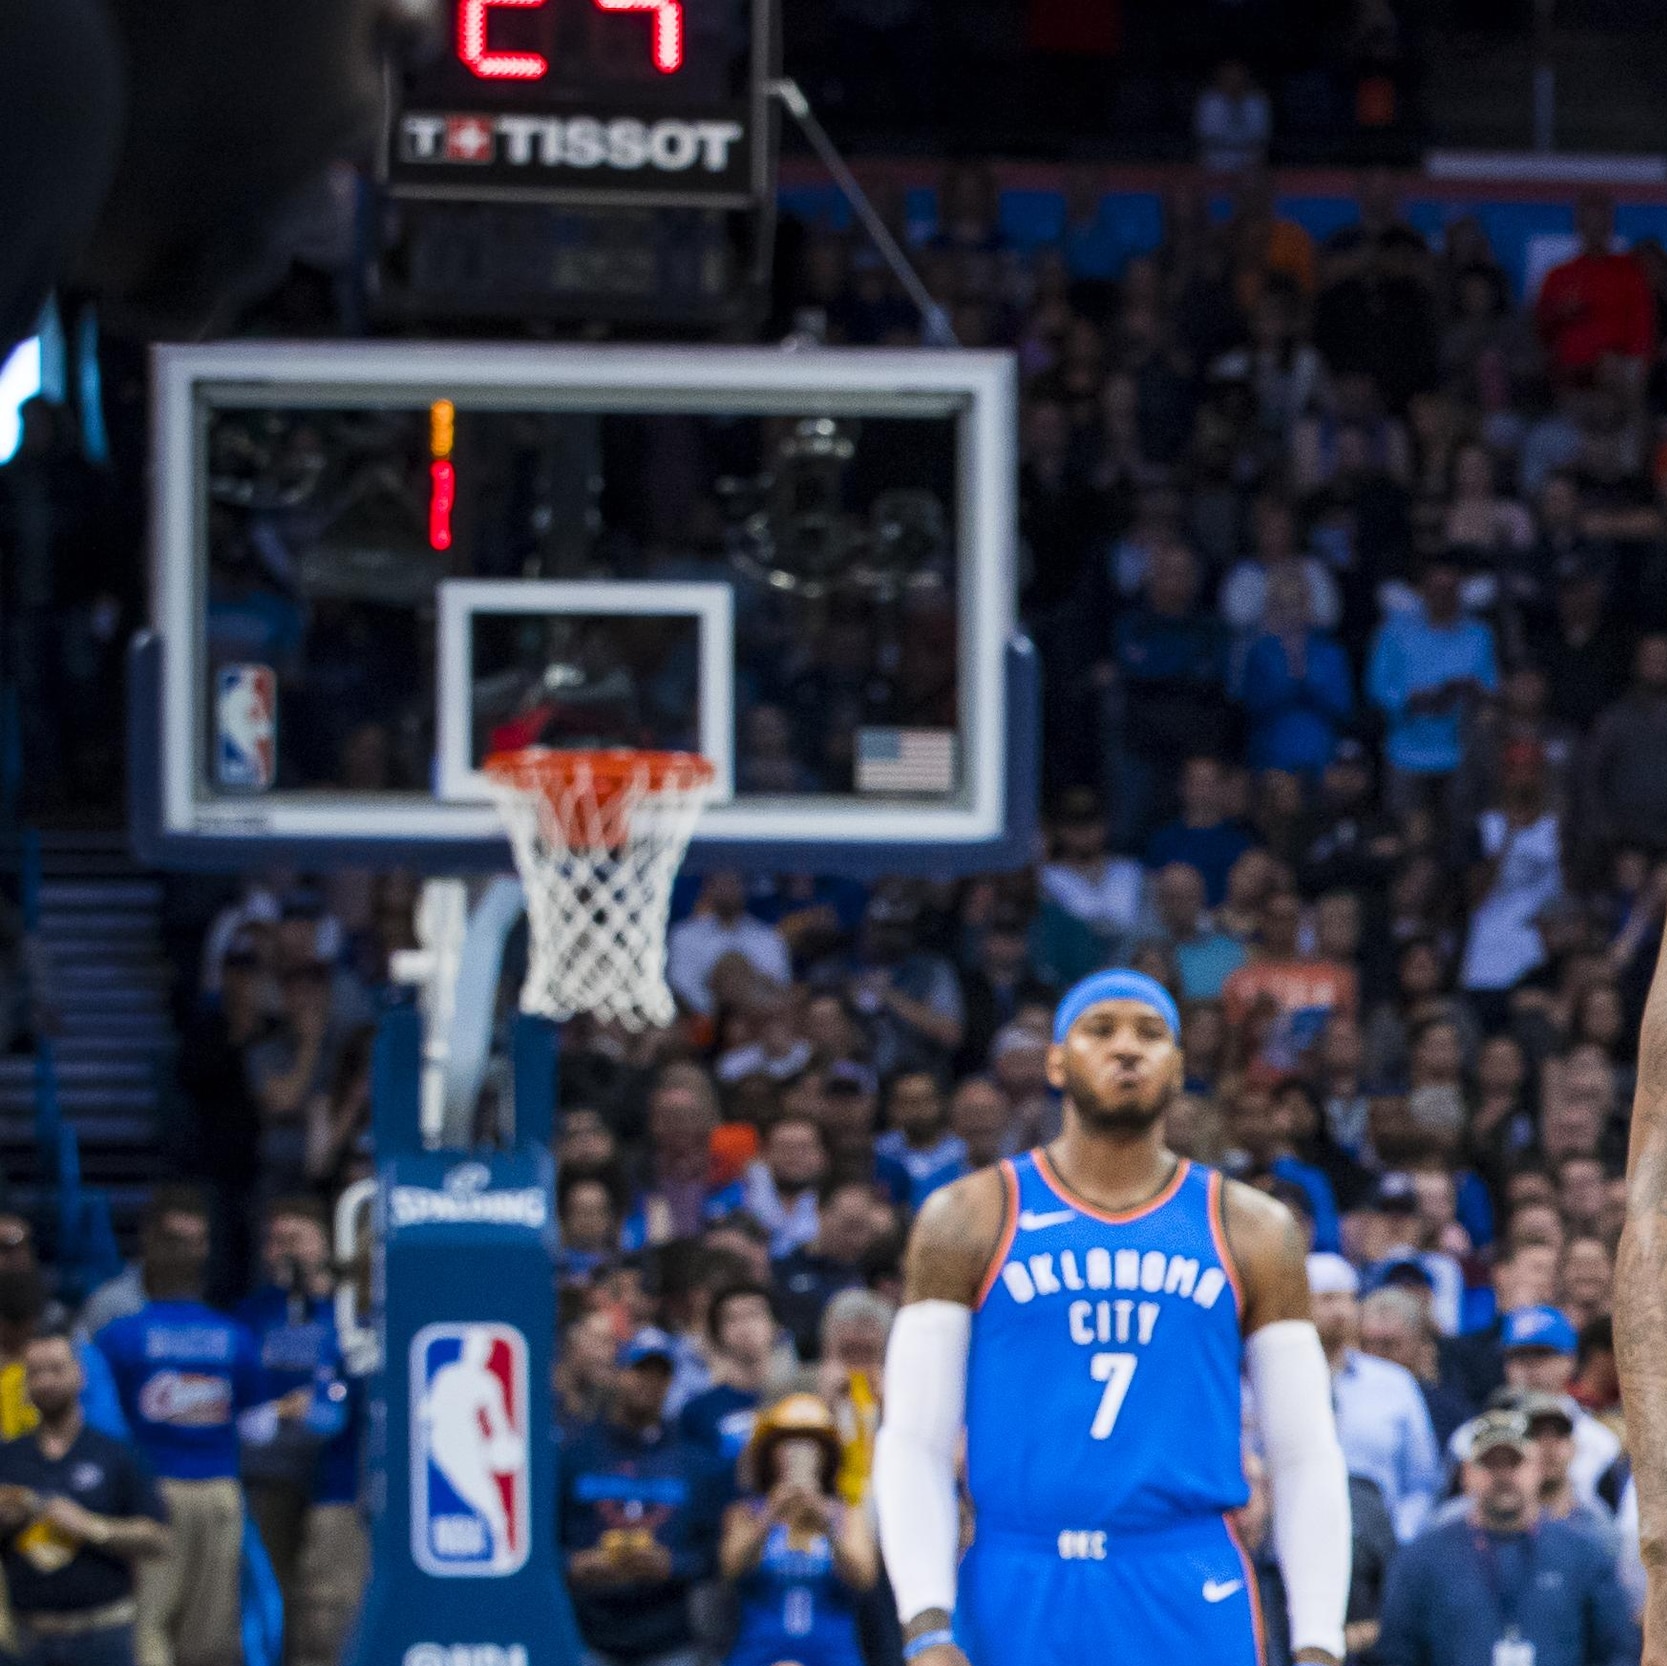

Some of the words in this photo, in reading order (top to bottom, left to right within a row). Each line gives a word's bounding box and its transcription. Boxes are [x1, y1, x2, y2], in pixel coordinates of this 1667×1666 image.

[496, 113, 744, 173] TISSOT
[1001, 1246, 1227, 1310] OKLAHOMA
[1067, 1299, 1162, 1346] CITY
[1089, 1351, 1139, 1441] 7
